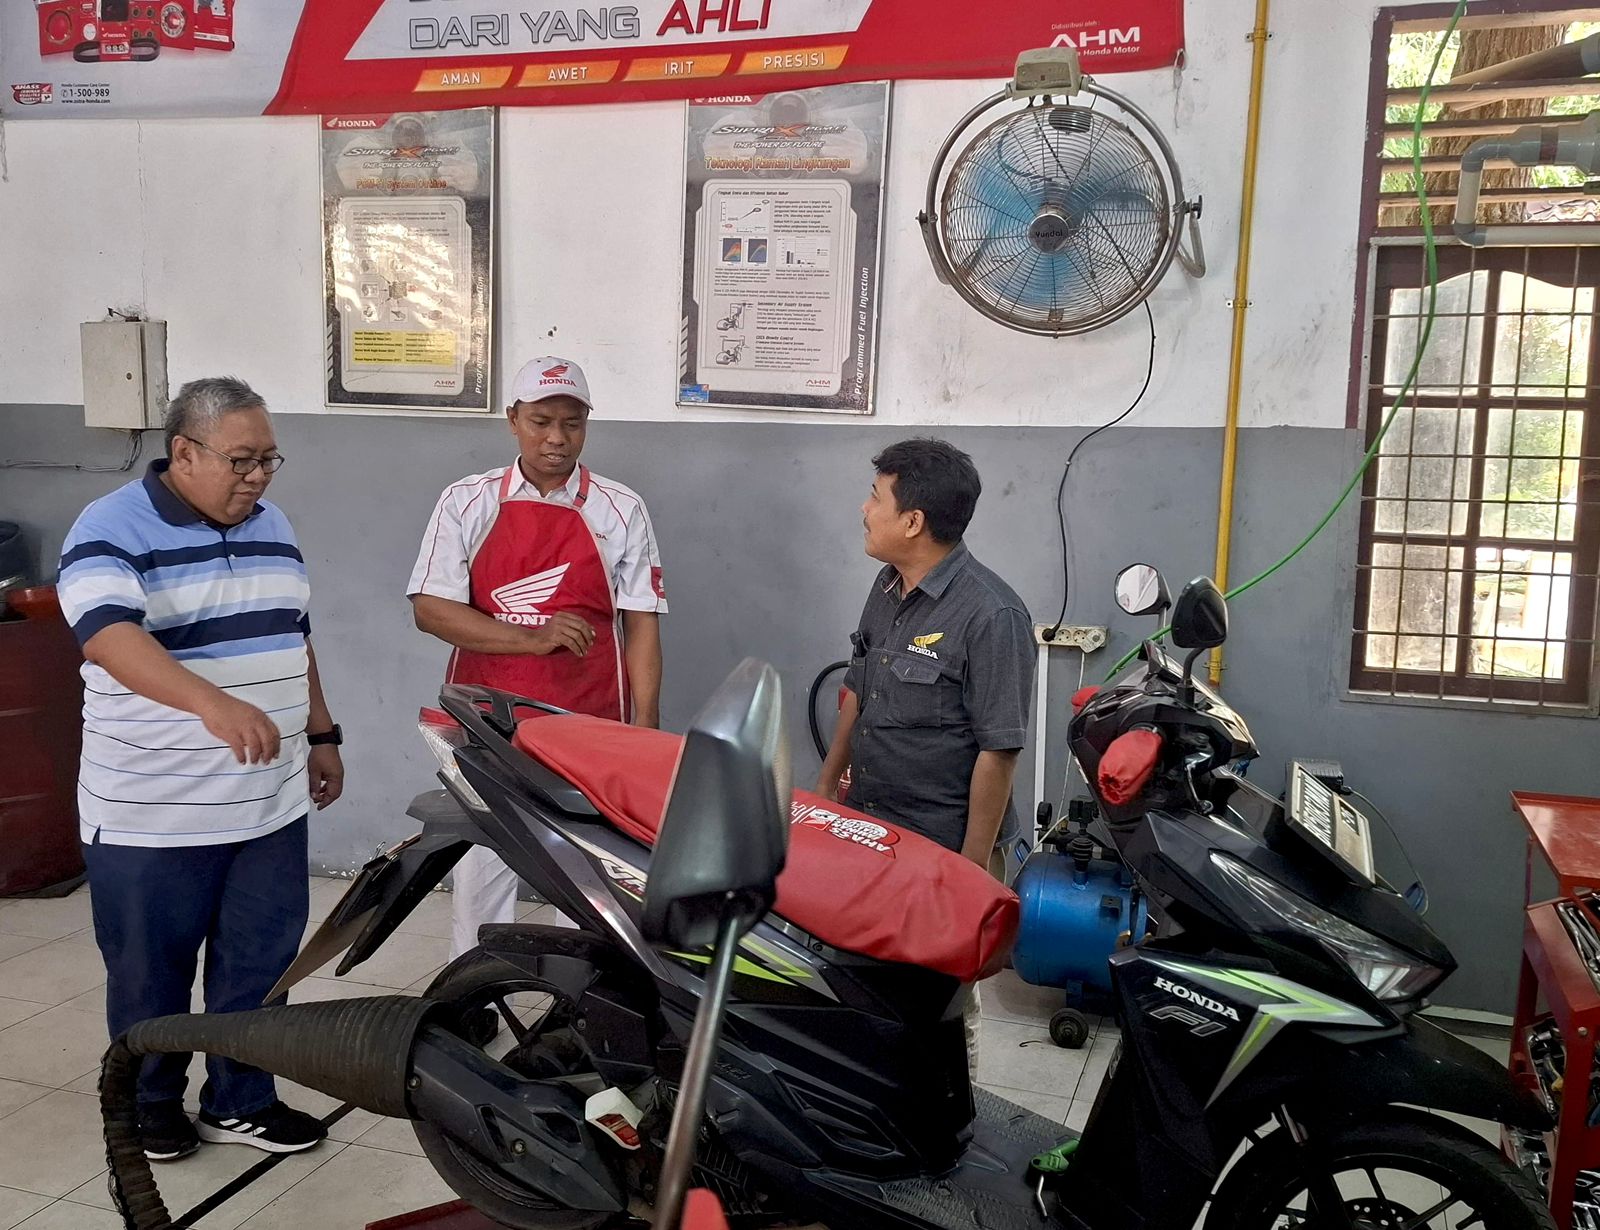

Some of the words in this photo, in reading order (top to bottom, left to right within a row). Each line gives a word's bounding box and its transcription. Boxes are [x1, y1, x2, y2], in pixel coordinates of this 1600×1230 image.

[409, 14, 509, 49] DARI
[520, 7, 640, 44] YANG
[656, 0, 772, 36] AHLI
[1050, 26, 1141, 48] AHM
[1083, 48, 1111, 56] Honda
[1113, 46, 1140, 54] Motor
[664, 61, 694, 75] IRIT
[763, 53, 825, 69] PRESISI
[441, 72, 482, 85] AMAN
[547, 67, 588, 80] AWET
[69, 88, 110, 97] 1-500-989
[707, 95, 753, 103] HONDA
[337, 119, 377, 127] HONDA
[705, 157, 754, 172] Teknologi
[754, 157, 790, 170] Ramah
[791, 156, 852, 172] Lingkungan
[859, 267, 869, 308] Injection
[857, 310, 867, 332] Fuel
[854, 333, 865, 395] Programmed
[538, 378, 577, 388] HONDA
[493, 612, 553, 625] HON
[906, 643, 939, 660] HONDA
[1153, 976, 1241, 1022] HONDA
[1149, 1004, 1229, 1038] FI
